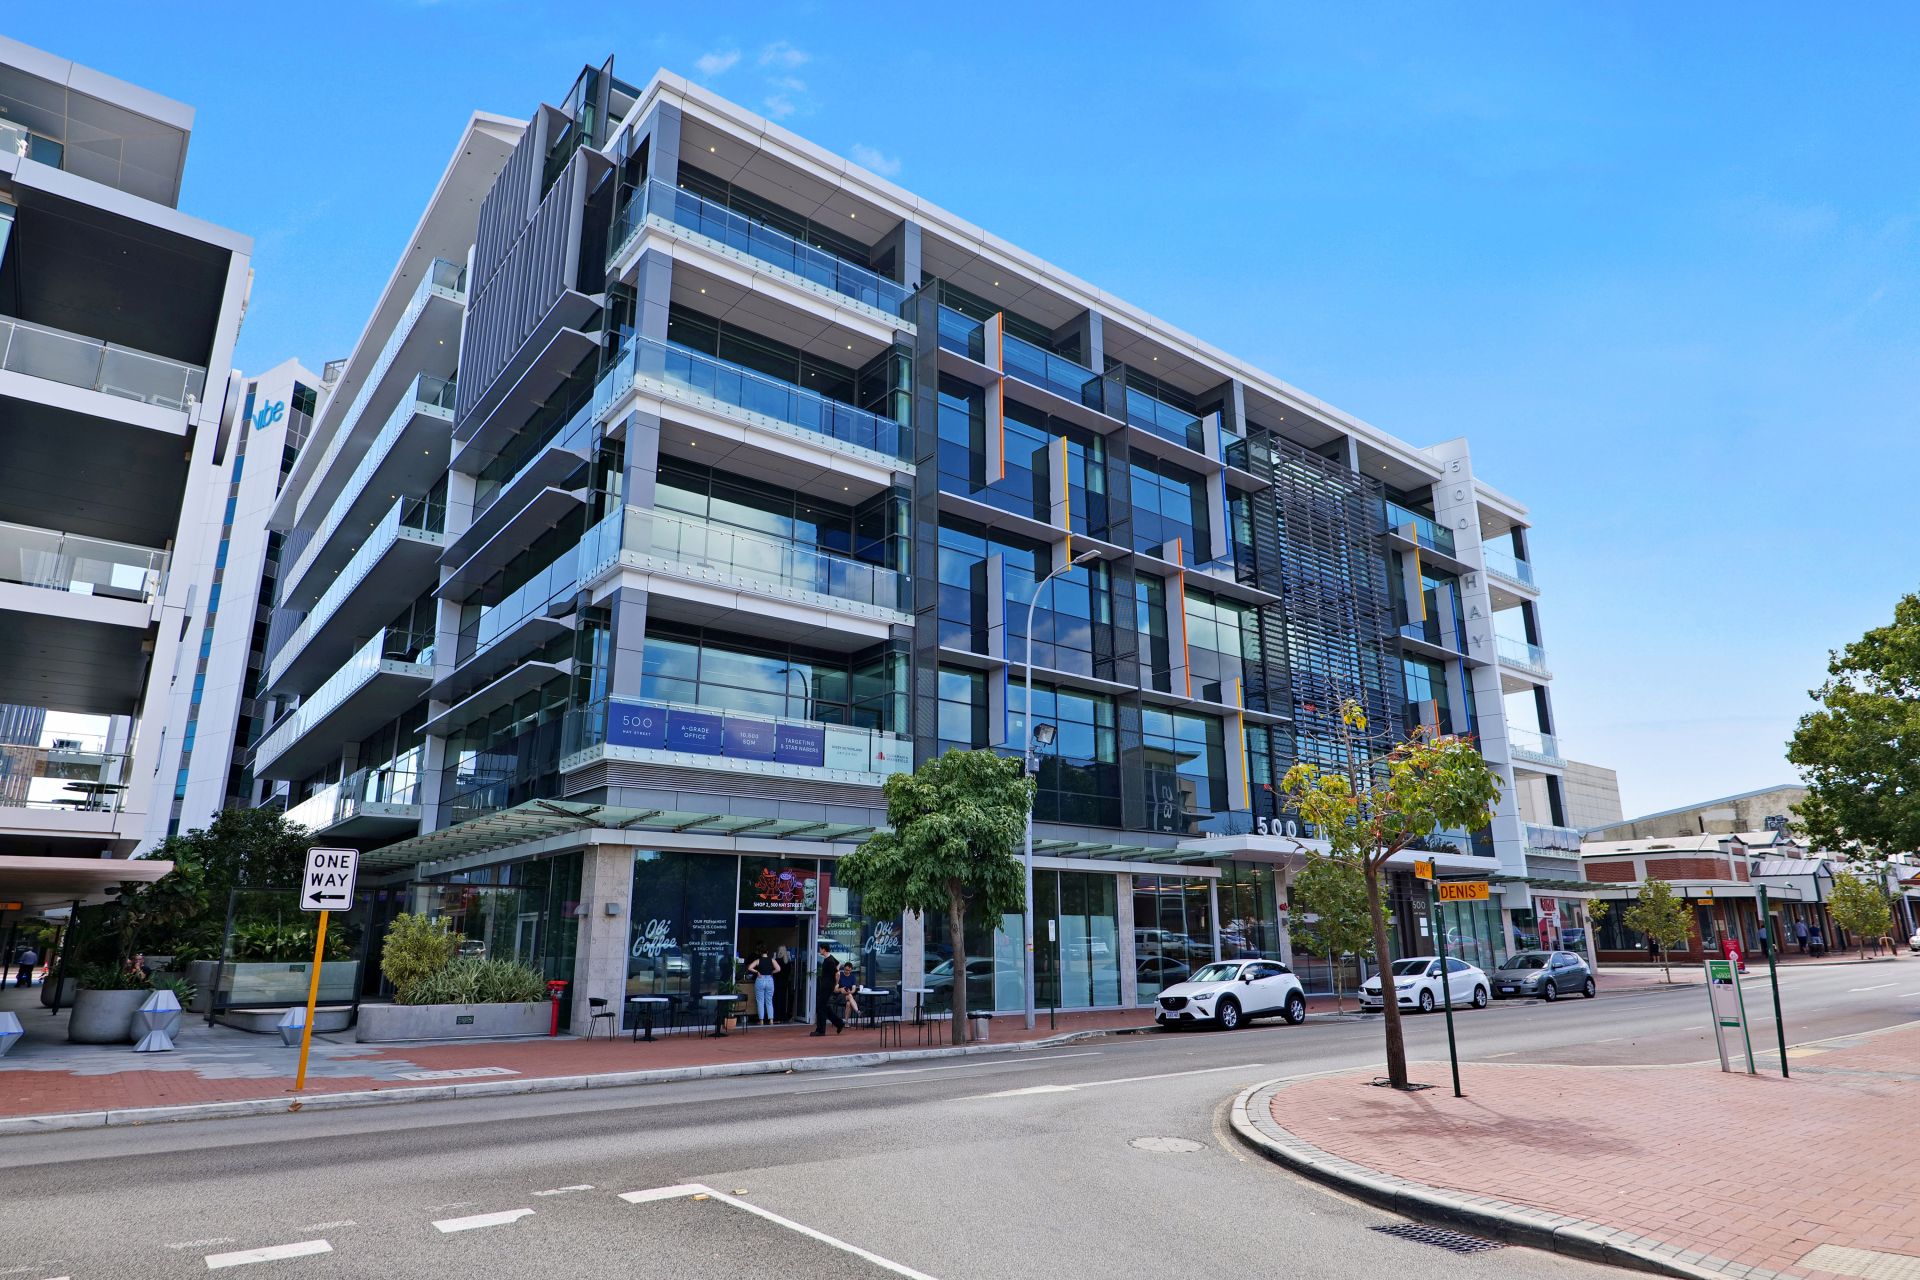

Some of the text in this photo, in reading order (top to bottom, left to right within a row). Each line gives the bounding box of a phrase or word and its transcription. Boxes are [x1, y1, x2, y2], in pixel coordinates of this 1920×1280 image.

[253, 400, 284, 431] vibe
[623, 715, 652, 728] 500
[681, 725, 709, 734] A-GRADE
[684, 732, 706, 740] OFFICE
[785, 737, 815, 747] TARGETING
[785, 744, 798, 752] STAR
[1257, 816, 1297, 838] 500
[314, 854, 350, 868] ONE
[311, 873, 349, 887] WAY
[1440, 884, 1486, 899] DENIS ST
[1412, 901, 1426, 910] 500
[645, 918, 671, 939] Obi
[874, 920, 894, 938] Obi
[632, 935, 677, 958] Coffee
[864, 935, 899, 954] Coffee
